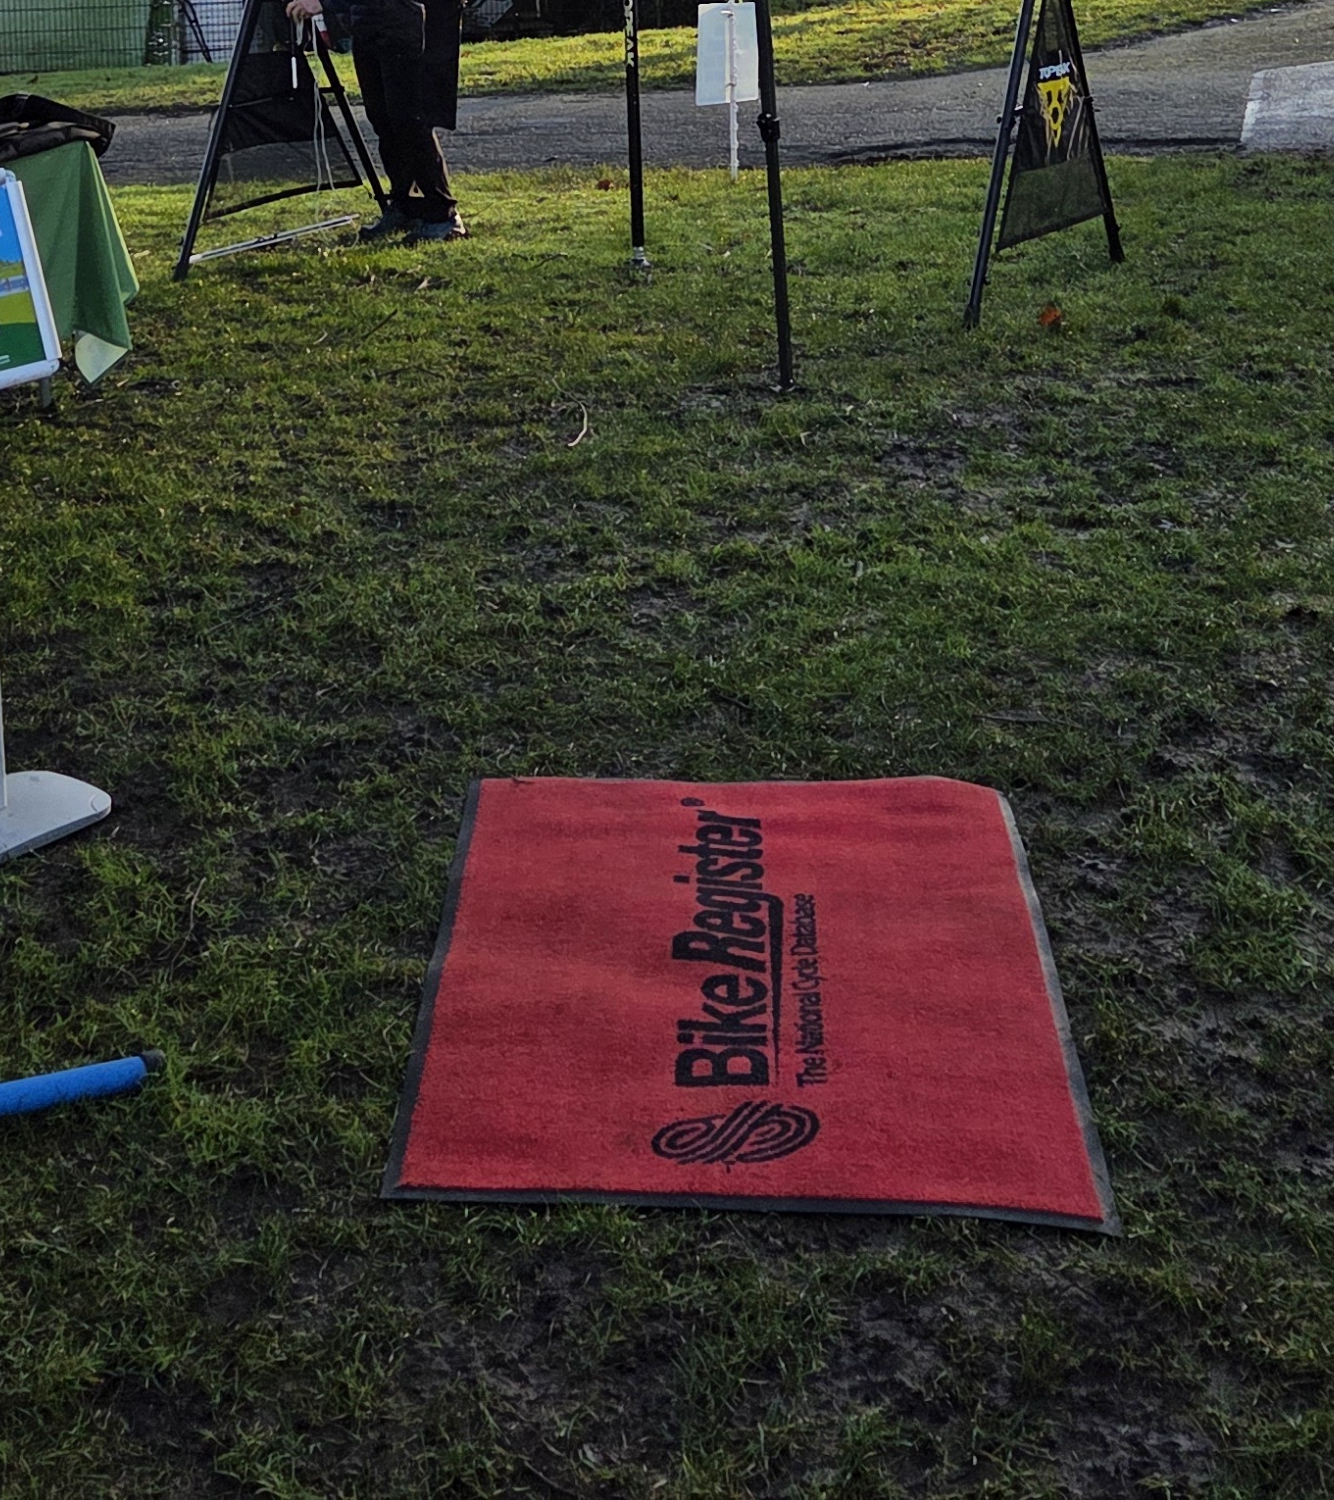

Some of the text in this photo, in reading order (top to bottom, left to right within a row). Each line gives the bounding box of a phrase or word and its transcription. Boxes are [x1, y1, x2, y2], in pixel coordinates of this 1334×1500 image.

[791, 893, 827, 1088] The National Cycle Database
